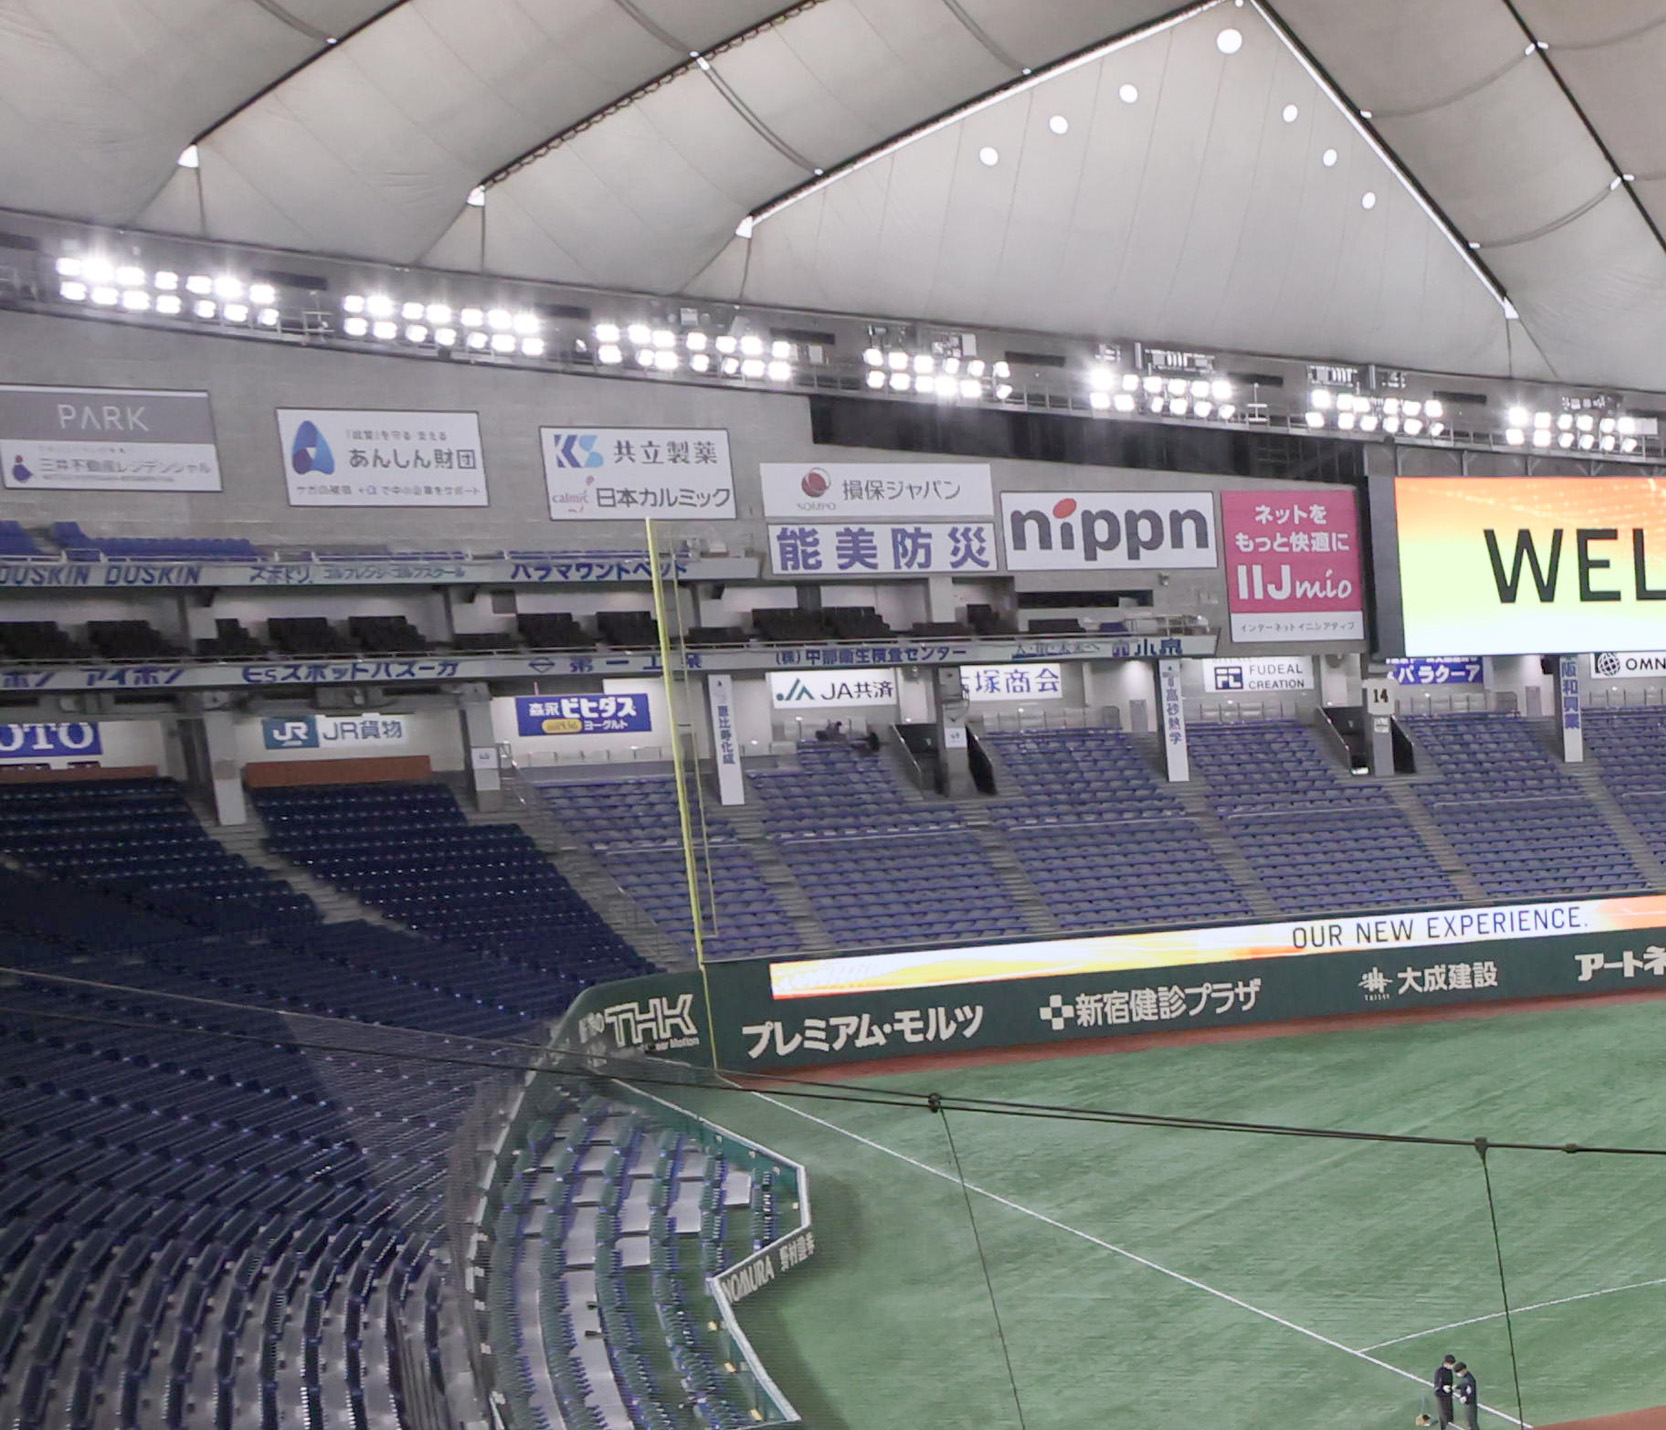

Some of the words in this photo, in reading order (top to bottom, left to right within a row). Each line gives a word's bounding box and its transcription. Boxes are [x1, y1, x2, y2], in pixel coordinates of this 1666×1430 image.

[58, 404, 148, 431] PARK
[349, 449, 477, 469] あんしん財団
[614, 440, 718, 465] 共立製薬
[596, 488, 730, 508] 日本カルミック
[843, 480, 960, 500] 損保ジャパン
[1255, 505, 1327, 526] ネットを
[1010, 498, 1209, 561] nippn
[777, 526, 990, 571] 能美防災
[1236, 532, 1350, 552] もっと快適に
[105, 565, 202, 585] DUSKIN
[962, 667, 1061, 694] 塚商会
[1249, 664, 1303, 676] FUDEAL
[821, 680, 894, 700] JA共済
[1248, 679, 1304, 691] CREATION
[1373, 688, 1389, 703] 14
[323, 720, 403, 741] JR貨物
[1292, 924, 1343, 949] OUR
[1356, 918, 1414, 943] NEW
[1427, 906, 1589, 939] EXPERIENCE.
[1397, 961, 1498, 995] 大成建設
[1076, 978, 1262, 1027] 新宿健診プラザ
[604, 994, 698, 1048] THK
[742, 1005, 984, 1059] プレミアム・モルツ
[721, 1255, 775, 1303] NOMURA
